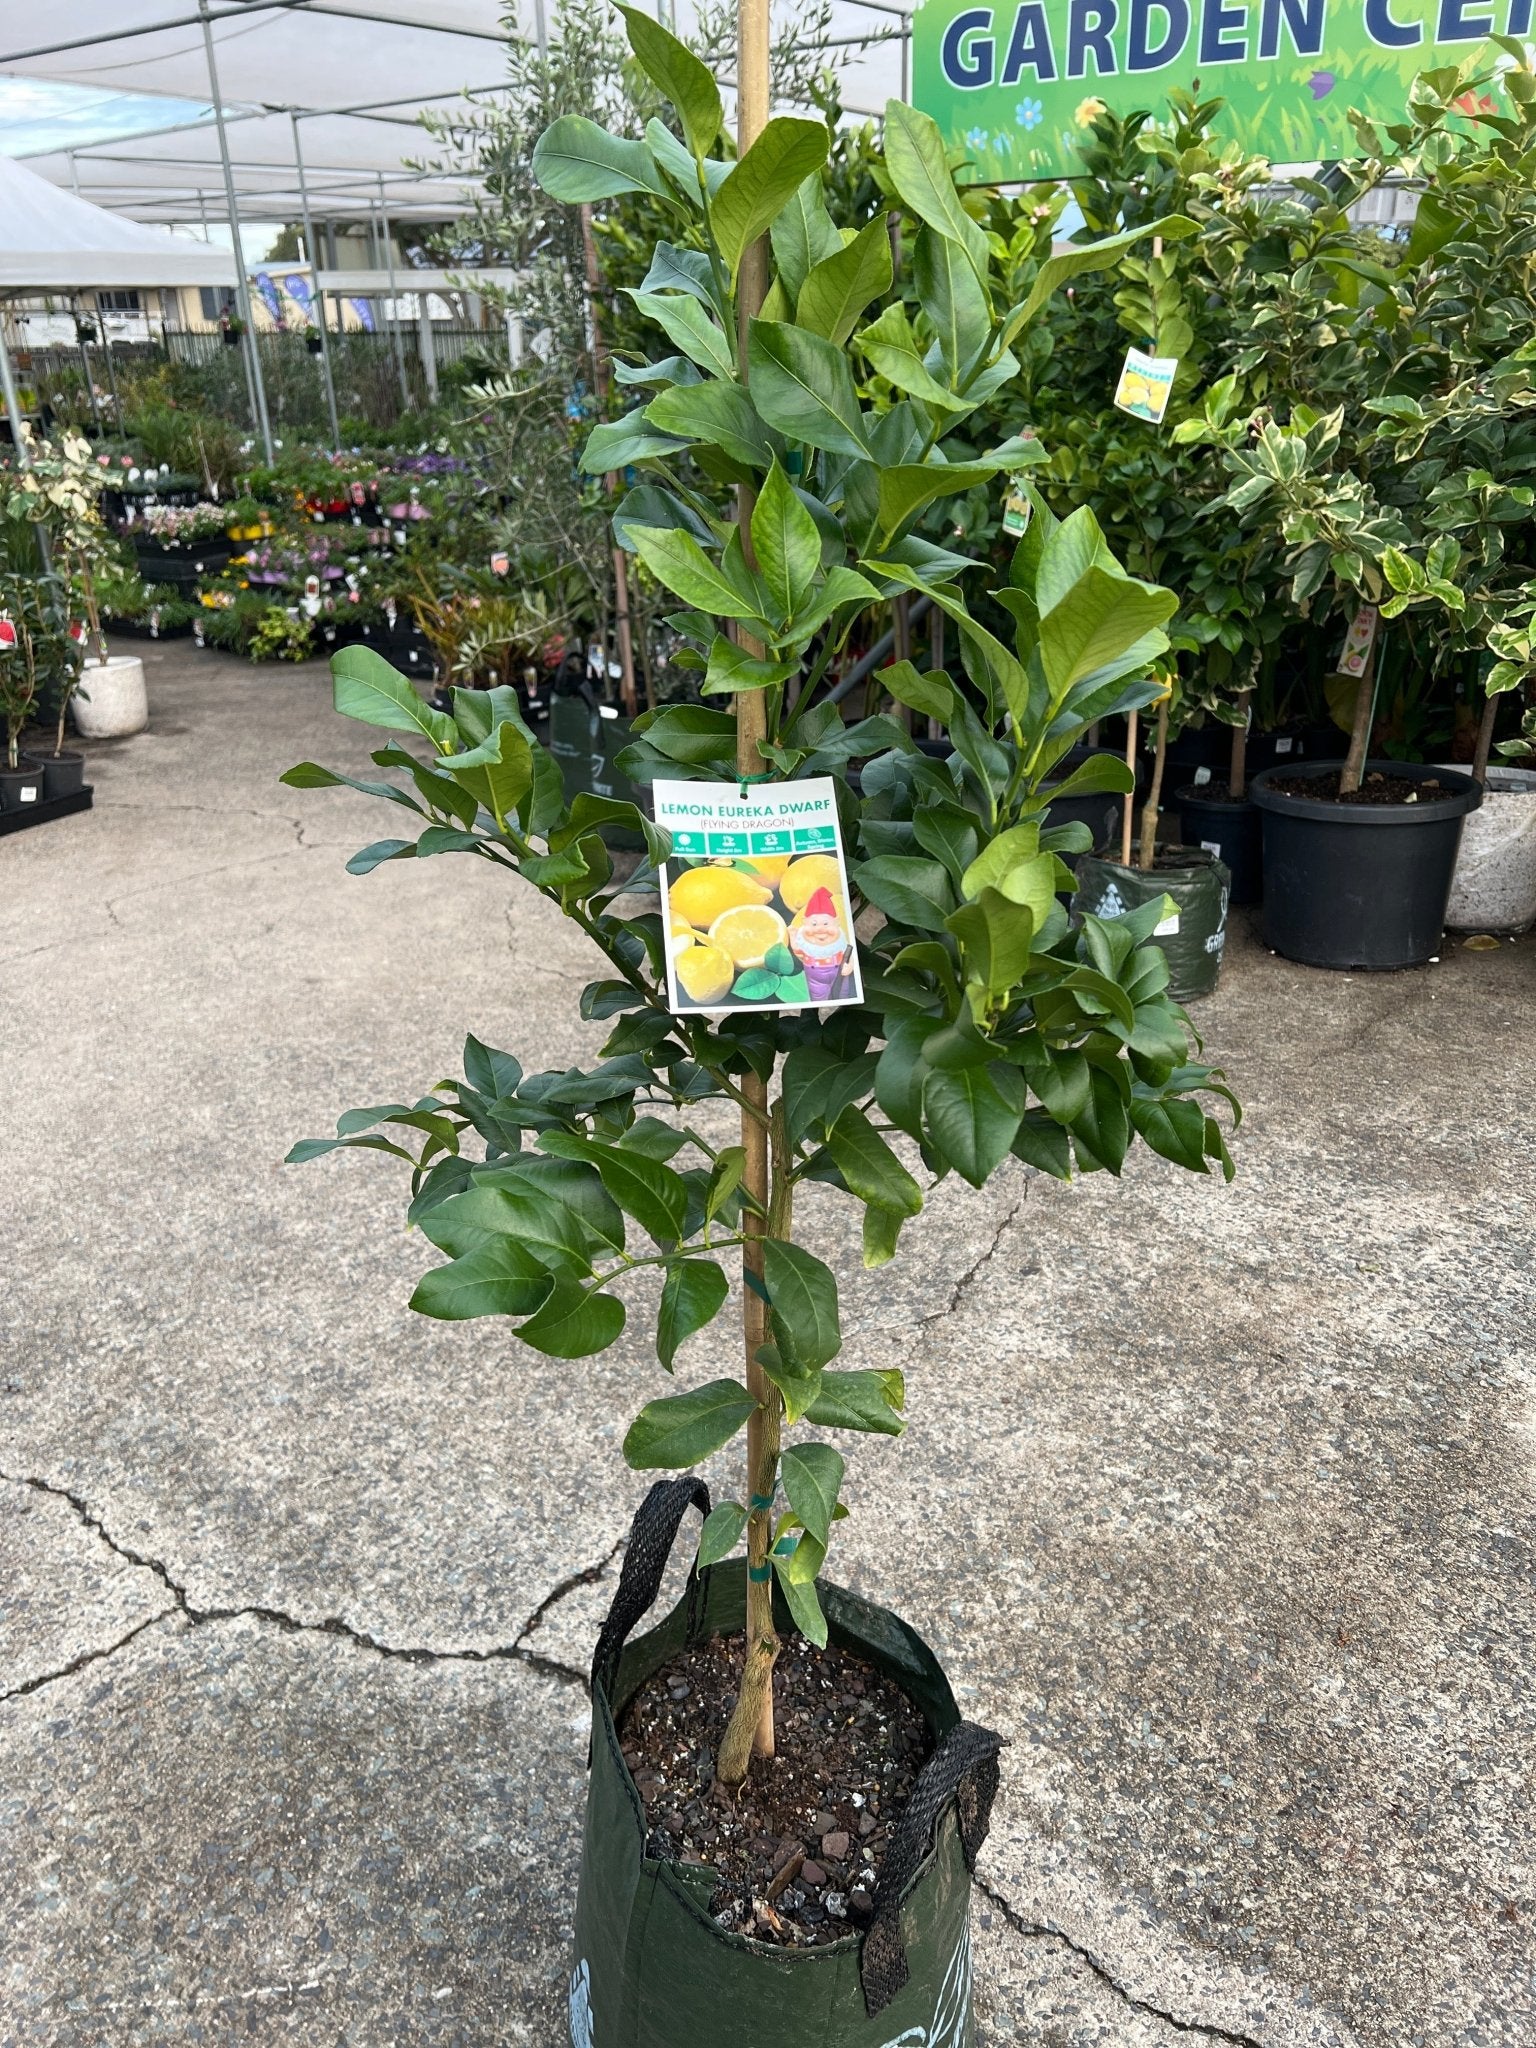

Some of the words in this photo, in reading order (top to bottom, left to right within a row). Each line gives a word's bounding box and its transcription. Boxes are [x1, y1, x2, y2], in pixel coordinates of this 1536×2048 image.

[940, 0, 1328, 90] GARDEN
[661, 803, 713, 816] LEMON
[718, 805, 774, 817] EUREKA
[779, 799, 830, 814] DWARF
[700, 819, 739, 830] (FLYING
[742, 817, 795, 829] DRAGON)
